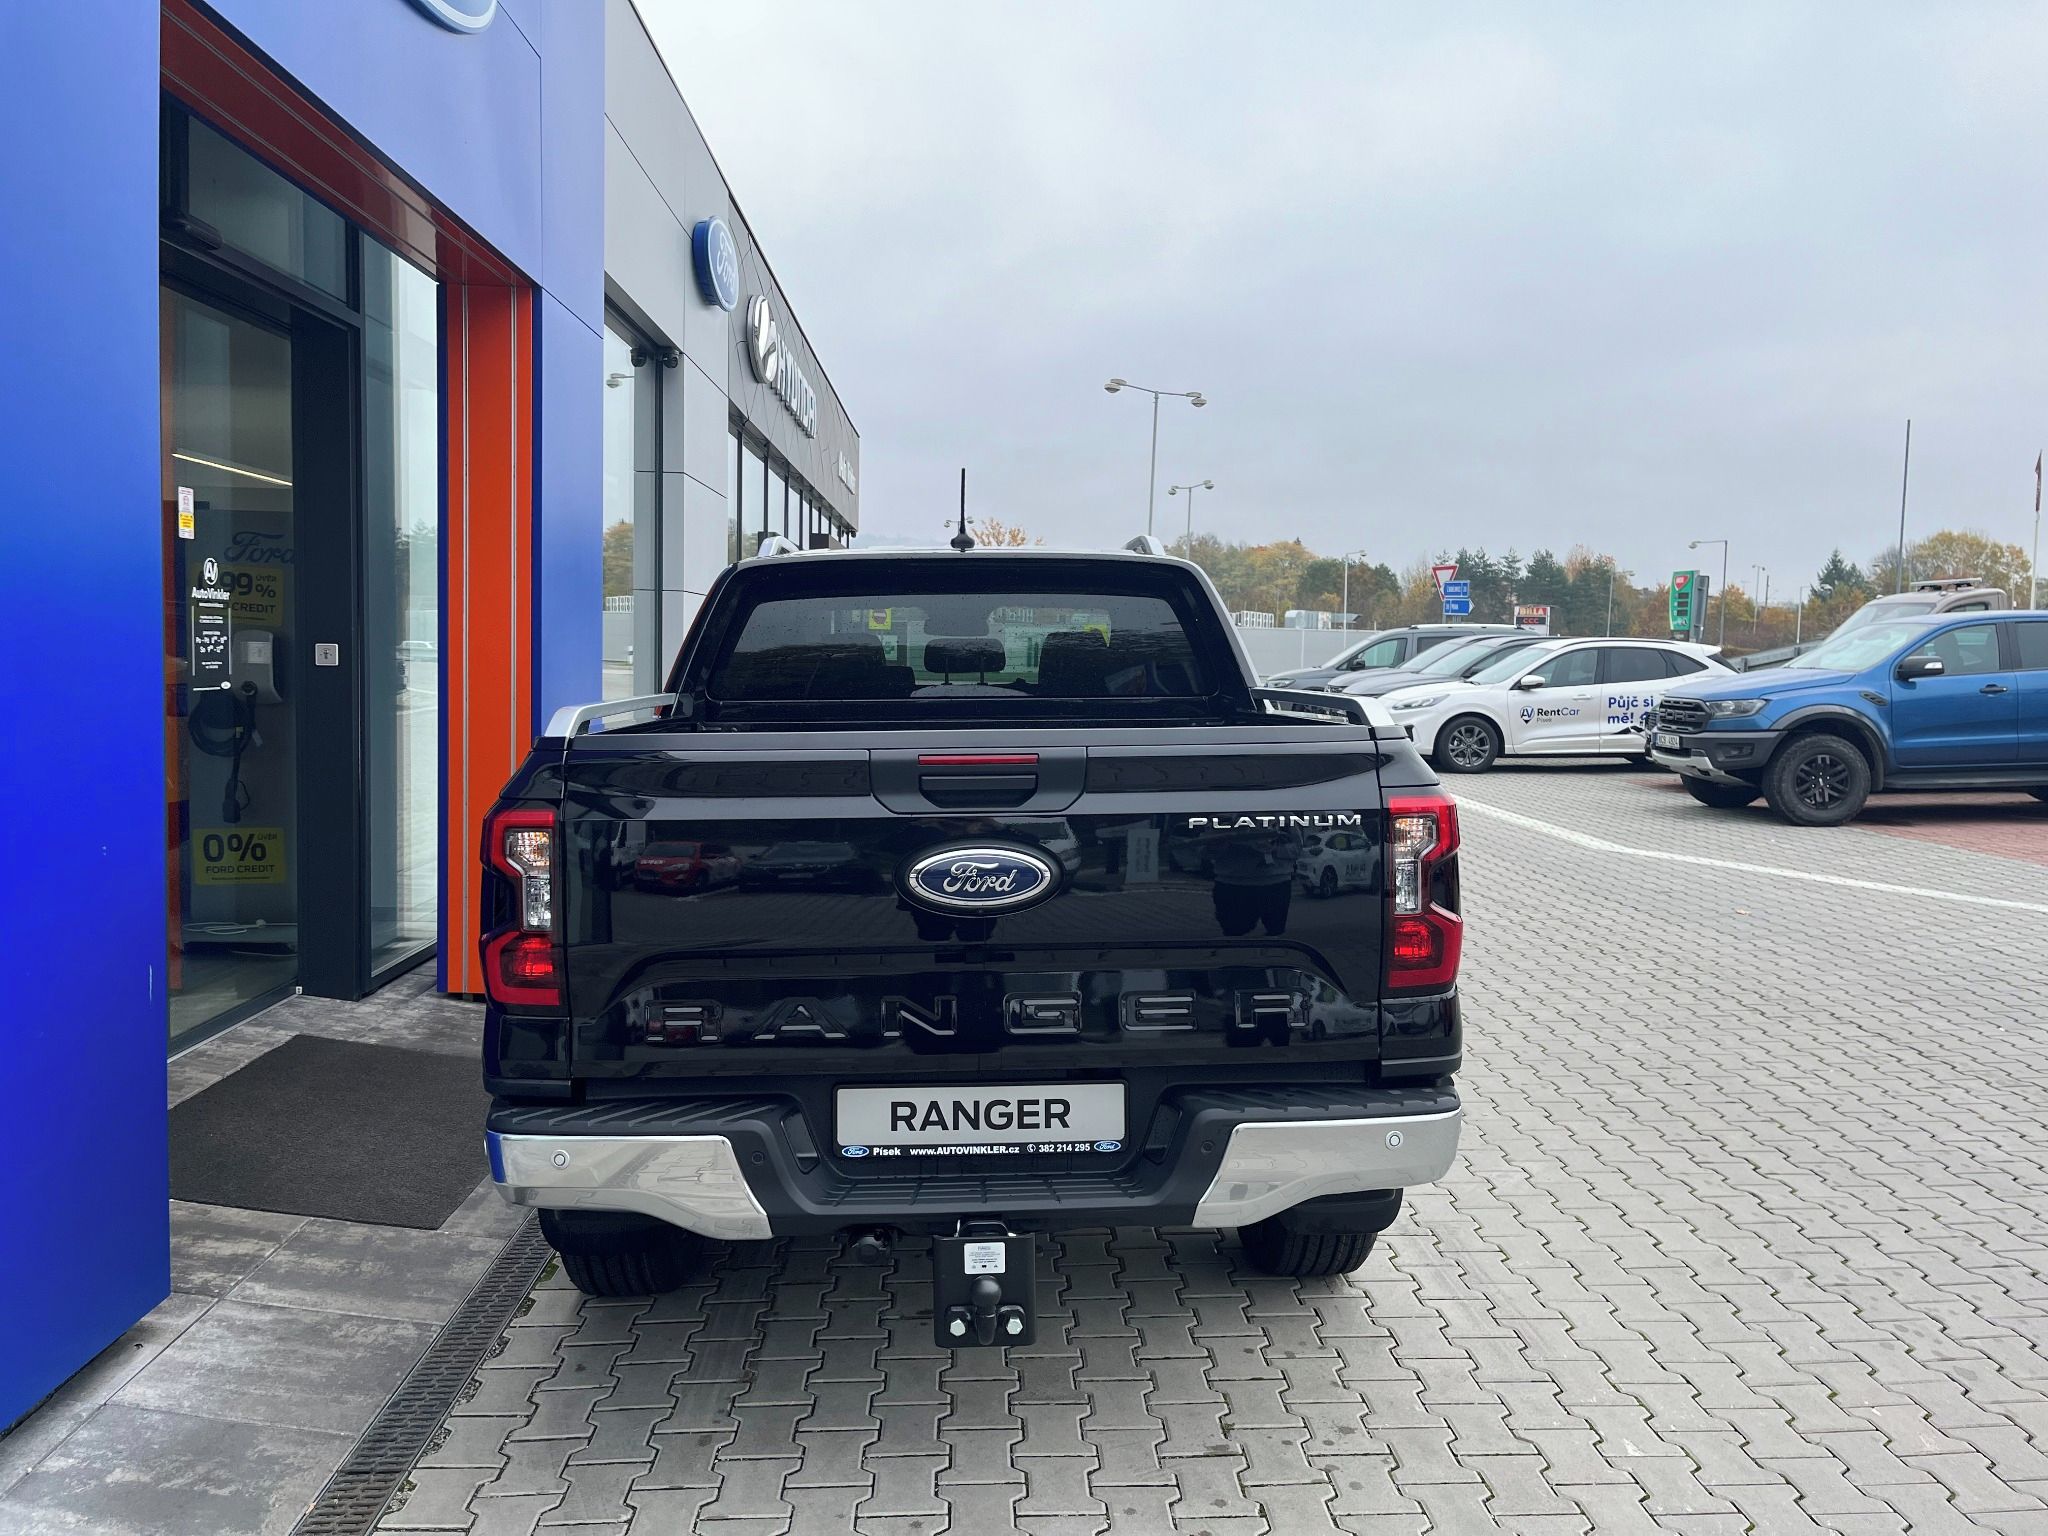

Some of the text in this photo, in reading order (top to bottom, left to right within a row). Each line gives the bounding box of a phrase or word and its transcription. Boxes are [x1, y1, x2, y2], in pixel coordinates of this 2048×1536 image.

[231, 602, 276, 614] CREDIT
[1608, 695, 1654, 711] Půjč si
[1537, 707, 1581, 716] RentCar
[1607, 712, 1634, 724] mě!
[1188, 814, 1362, 829] PLATINUM
[203, 833, 267, 862] 0%
[206, 864, 276, 874] FORD CREDIT
[943, 861, 1018, 893] Ford
[644, 989, 1311, 1042] RANGER
[890, 1098, 1071, 1132] RANGER
[873, 1143, 1091, 1156] Písek www.AUTOVINKLER.cz 382 214 295
